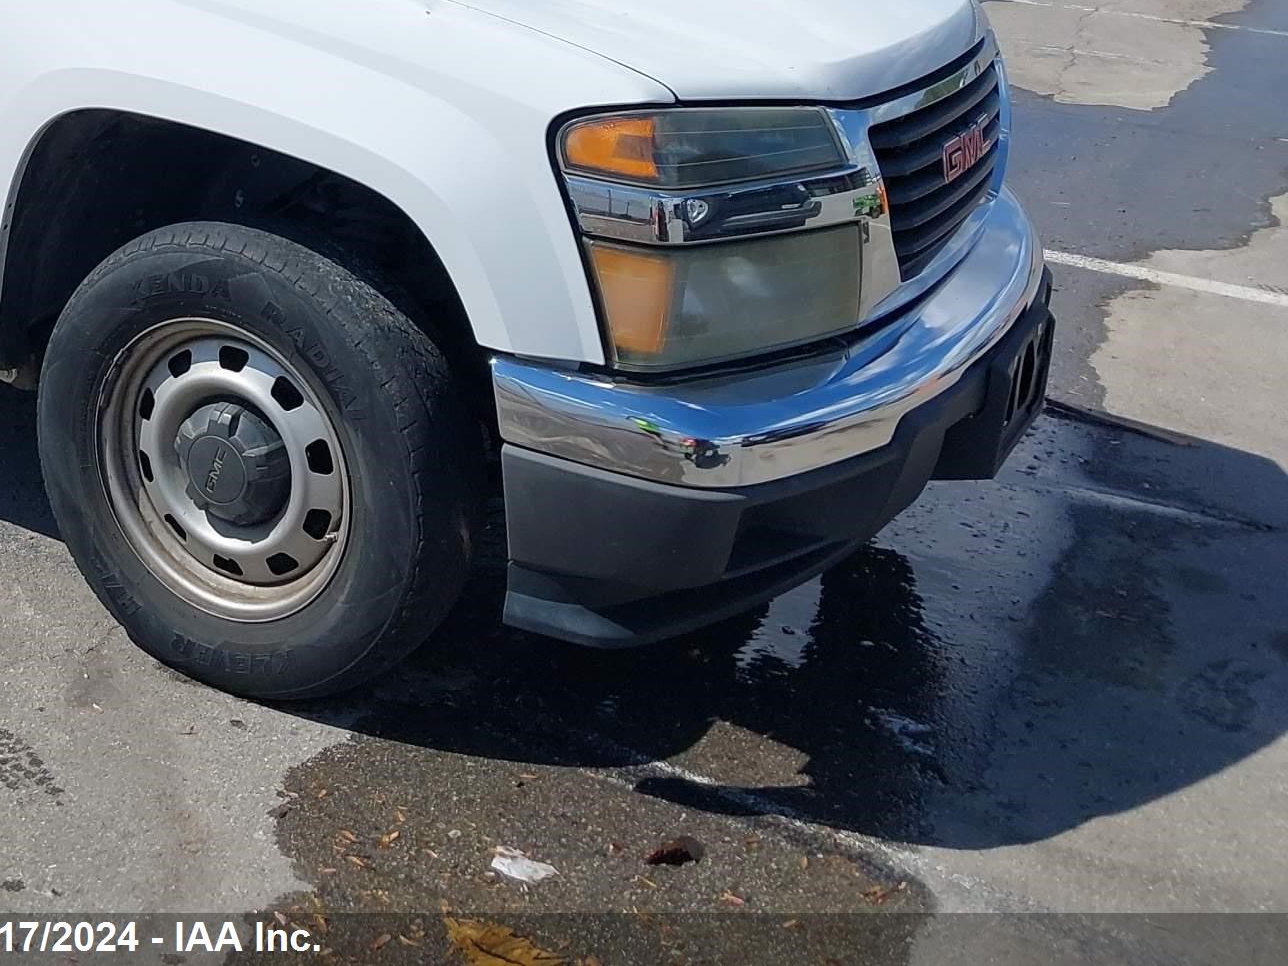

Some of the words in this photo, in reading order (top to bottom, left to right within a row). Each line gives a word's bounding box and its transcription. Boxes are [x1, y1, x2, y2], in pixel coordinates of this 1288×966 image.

[942, 112, 991, 184] GMC
[128, 273, 231, 307] KENDA
[260, 301, 368, 424] RADIAL
[205, 446, 227, 494] GMC
